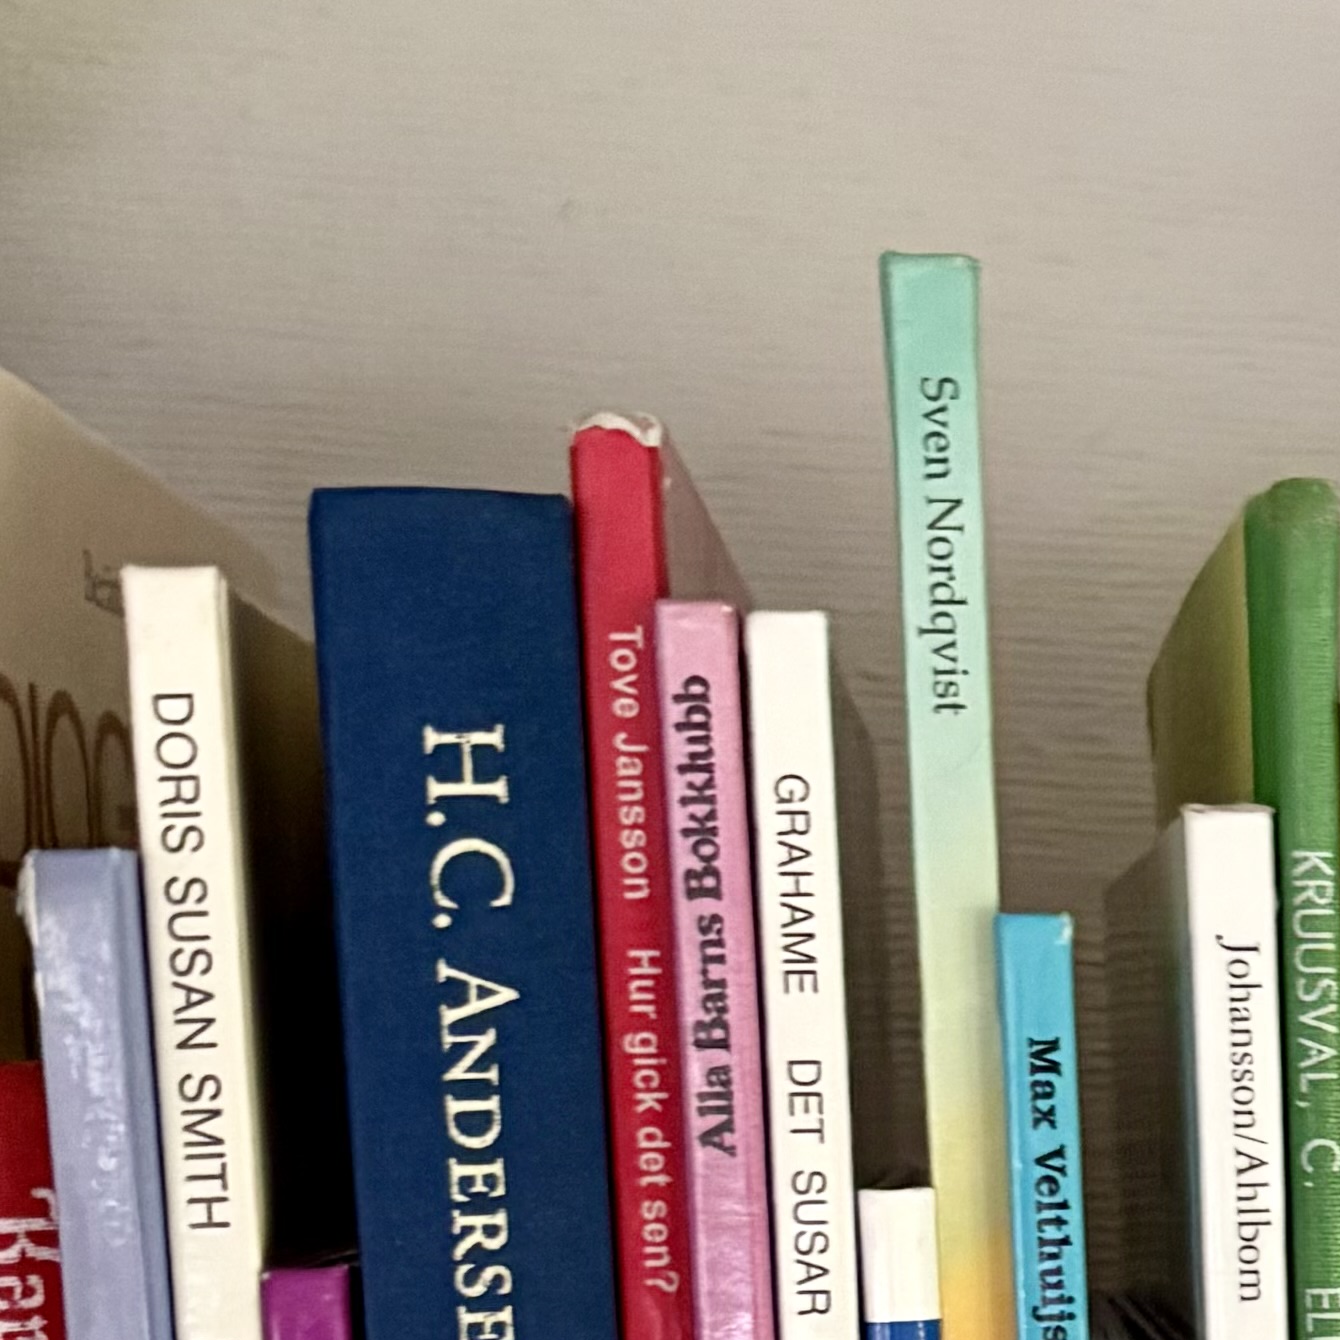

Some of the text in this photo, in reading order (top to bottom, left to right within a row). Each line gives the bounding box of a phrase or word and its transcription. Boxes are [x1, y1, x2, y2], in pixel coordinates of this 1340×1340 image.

[917, 376, 969, 715] Sven Nordqvist
[607, 626, 650, 899] Tove Jansson
[773, 773, 819, 994] GRAHAME
[151, 692, 231, 1231] DORIS SUSAN SMITH
[671, 674, 739, 1158] Alla Barns Bokklubb
[622, 949, 678, 1294] Hur gick det sen?
[785, 1058, 825, 1144] DET
[1026, 1036, 1061, 1128] Max
[790, 1169, 832, 1317] SUSAR
